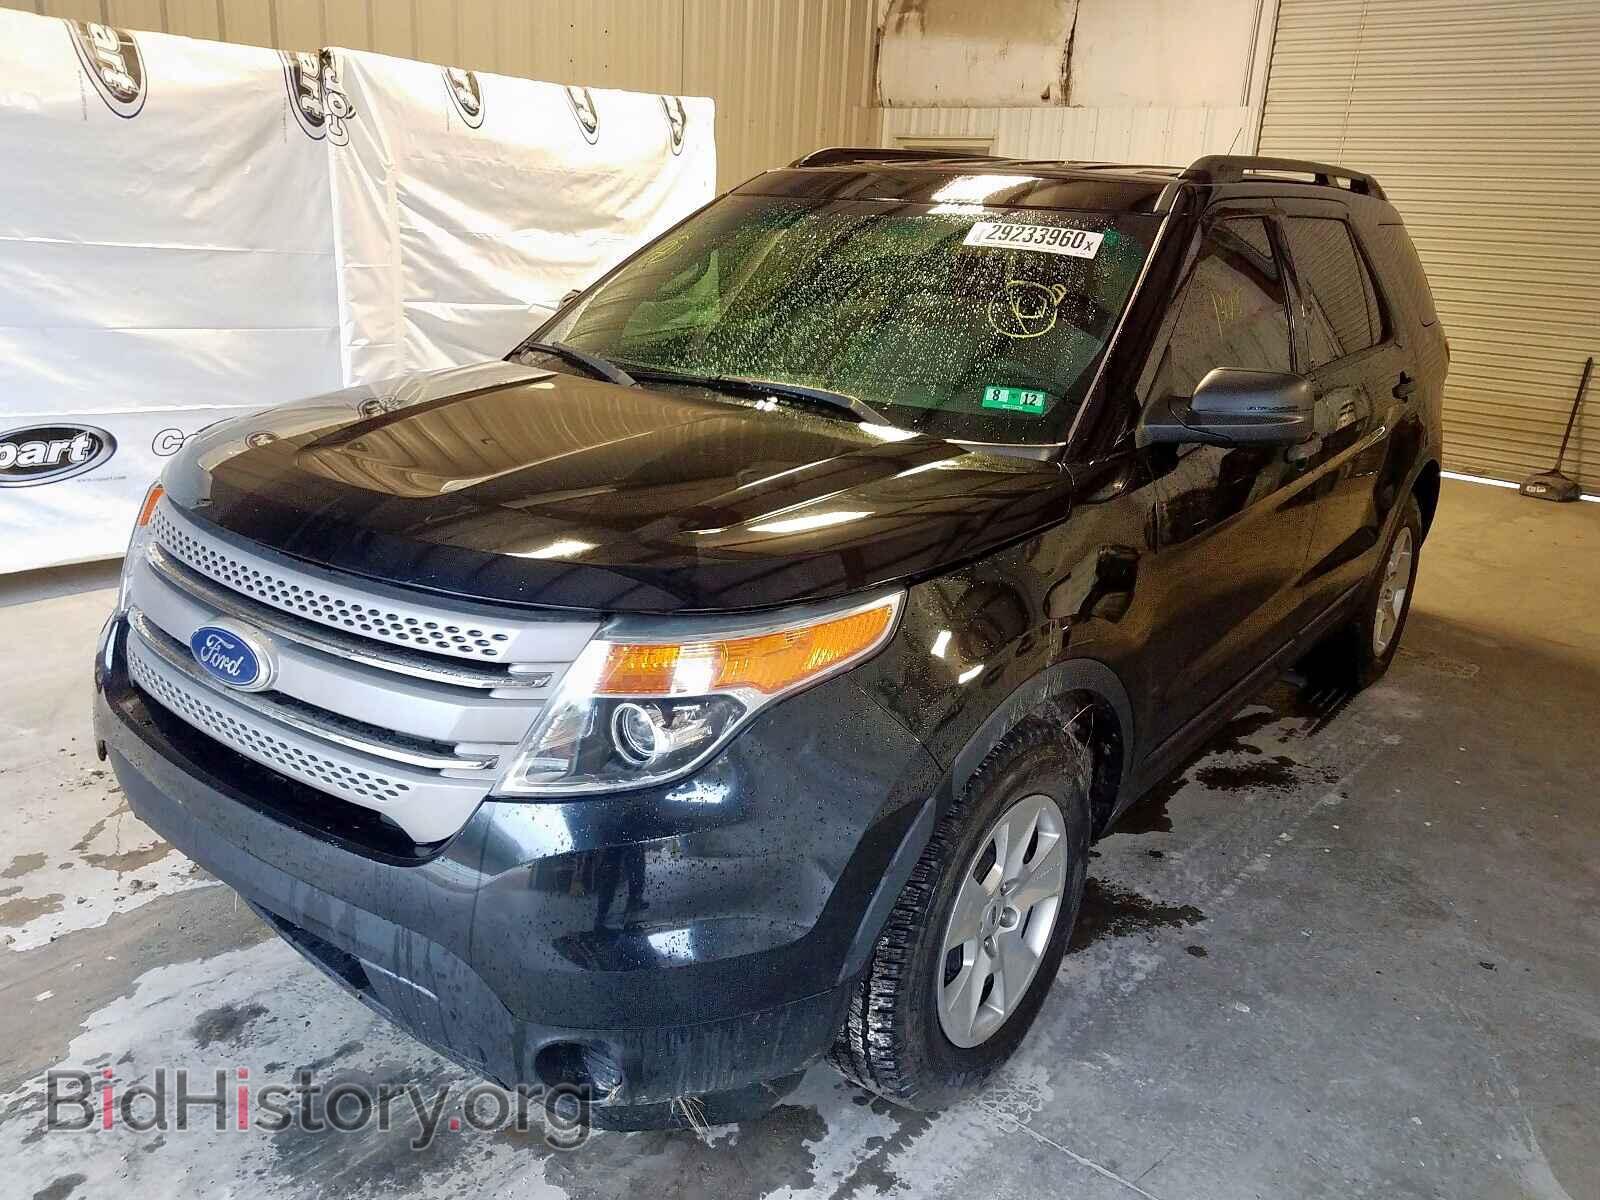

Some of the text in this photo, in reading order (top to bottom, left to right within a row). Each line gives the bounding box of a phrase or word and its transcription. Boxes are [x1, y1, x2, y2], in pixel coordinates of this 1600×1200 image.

[992, 389, 1038, 406] 8 12
[200, 634, 244, 677] Ford
